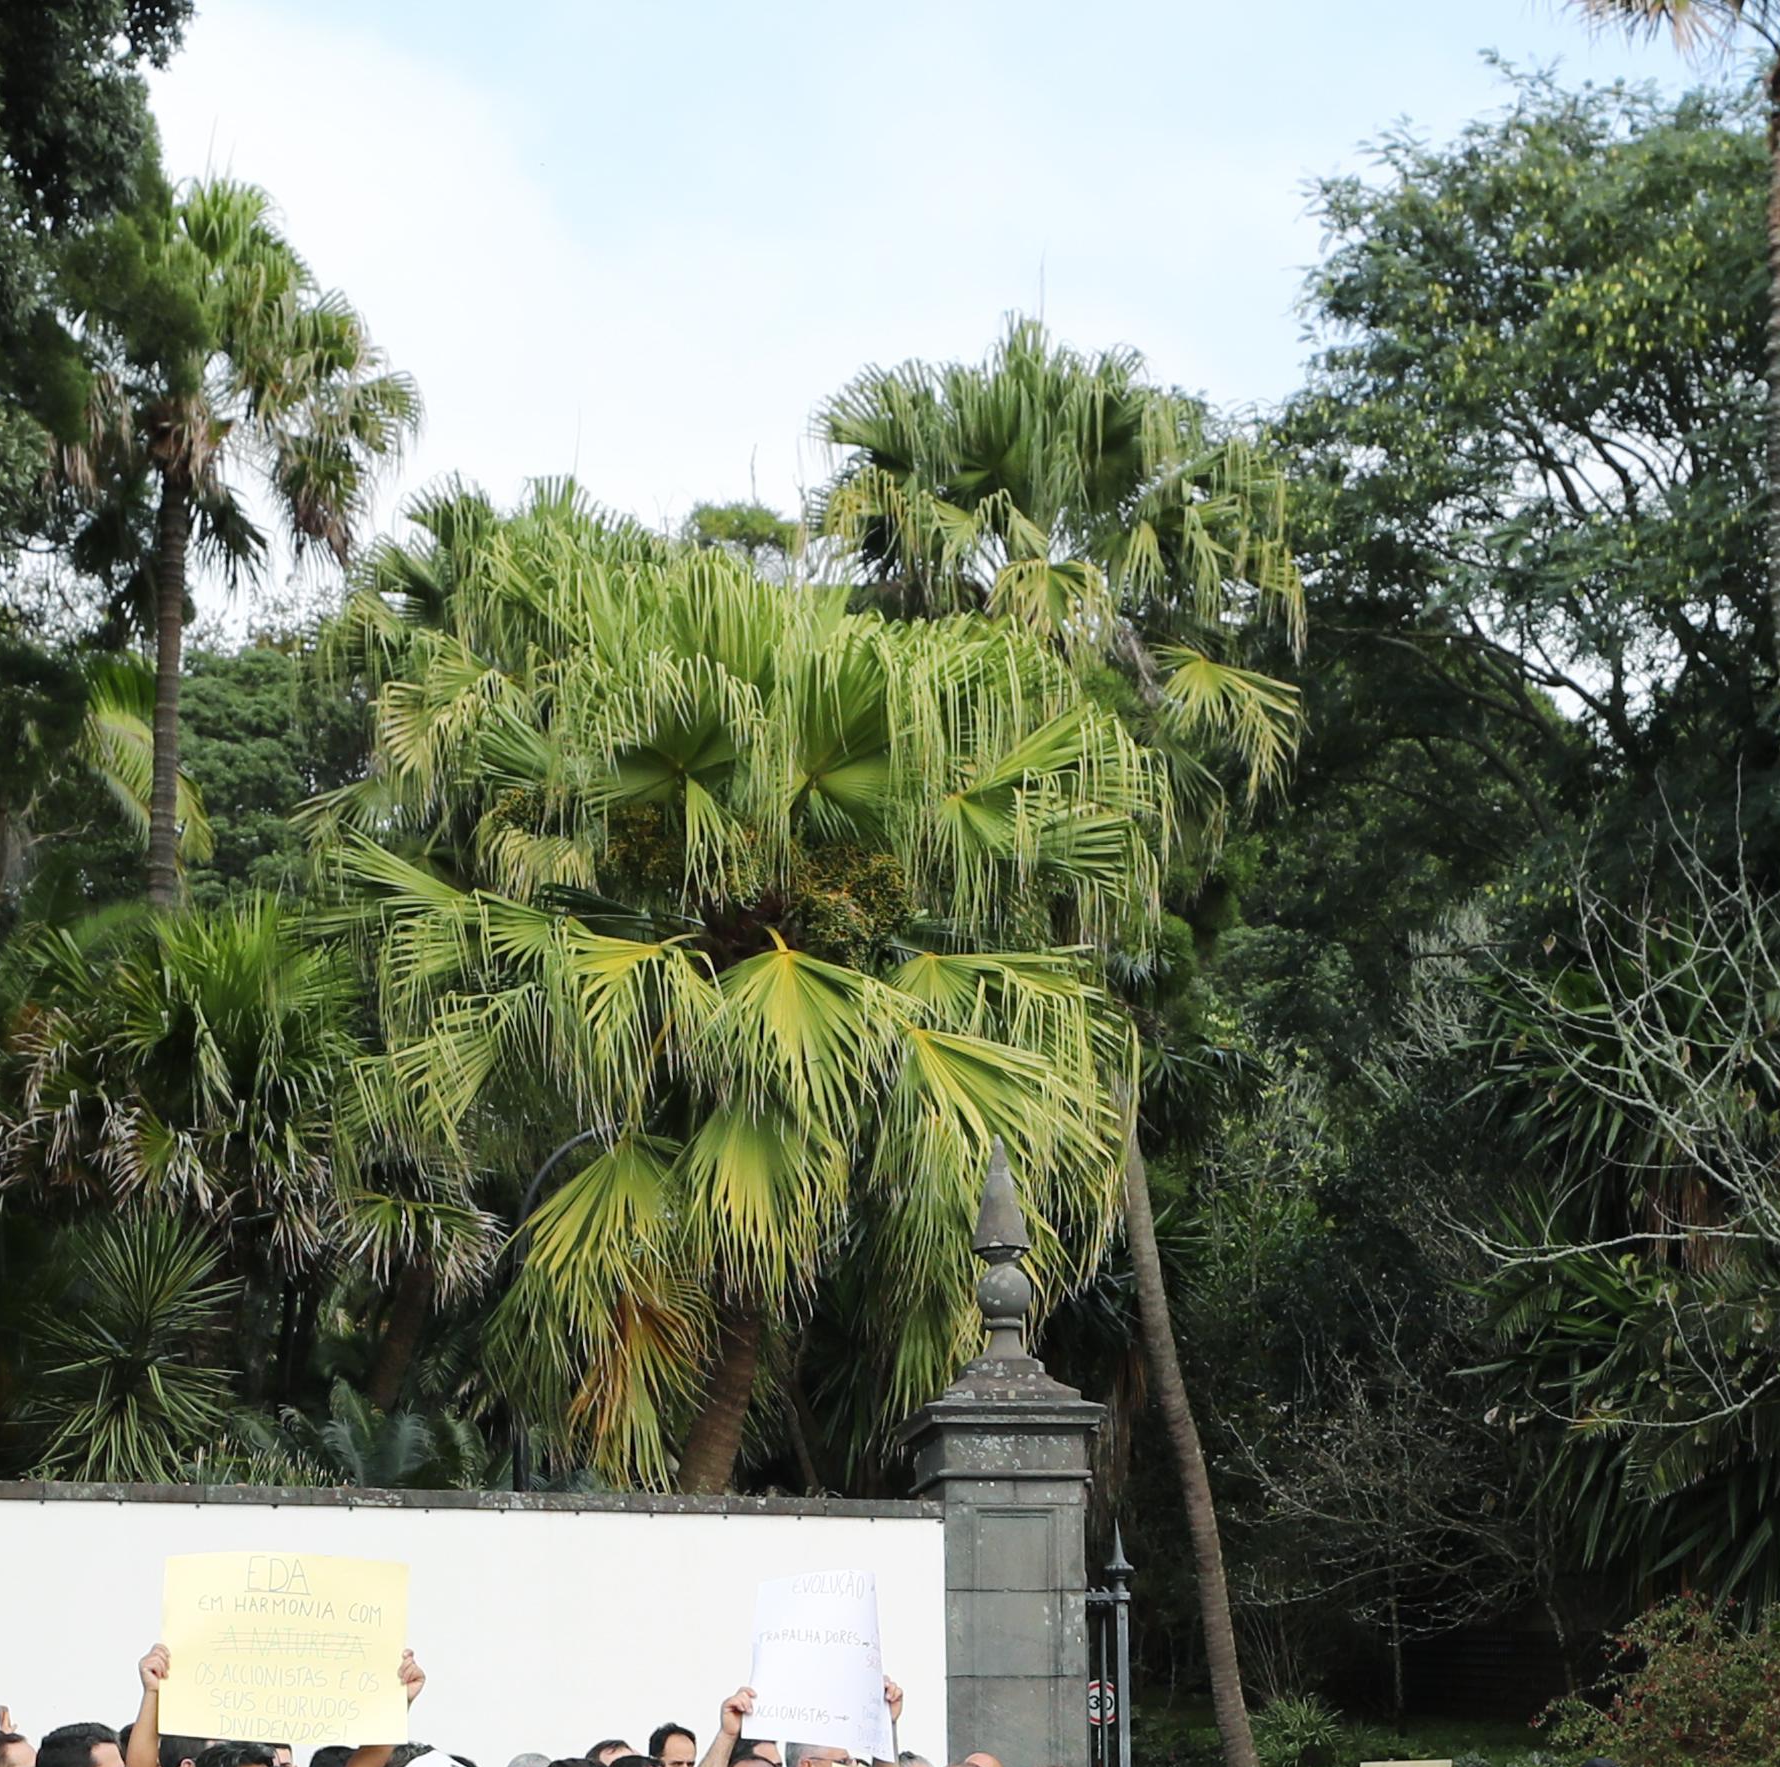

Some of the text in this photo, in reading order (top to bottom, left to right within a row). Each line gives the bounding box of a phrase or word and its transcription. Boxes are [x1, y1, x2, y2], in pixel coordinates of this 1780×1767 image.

[247, 1555, 310, 1594] EDA
[791, 1571, 866, 1600] EVOLUÇÃO
[198, 1595, 382, 1628] EM HARMONIA COM
[194, 1661, 380, 1693] OS ACCIONISTAS E OS
[210, 1687, 361, 1721] SEUS CHORUDOS
[755, 1705, 832, 1725] ACCIONISTAS
[218, 1714, 348, 1743] DIVIDENDOS!
